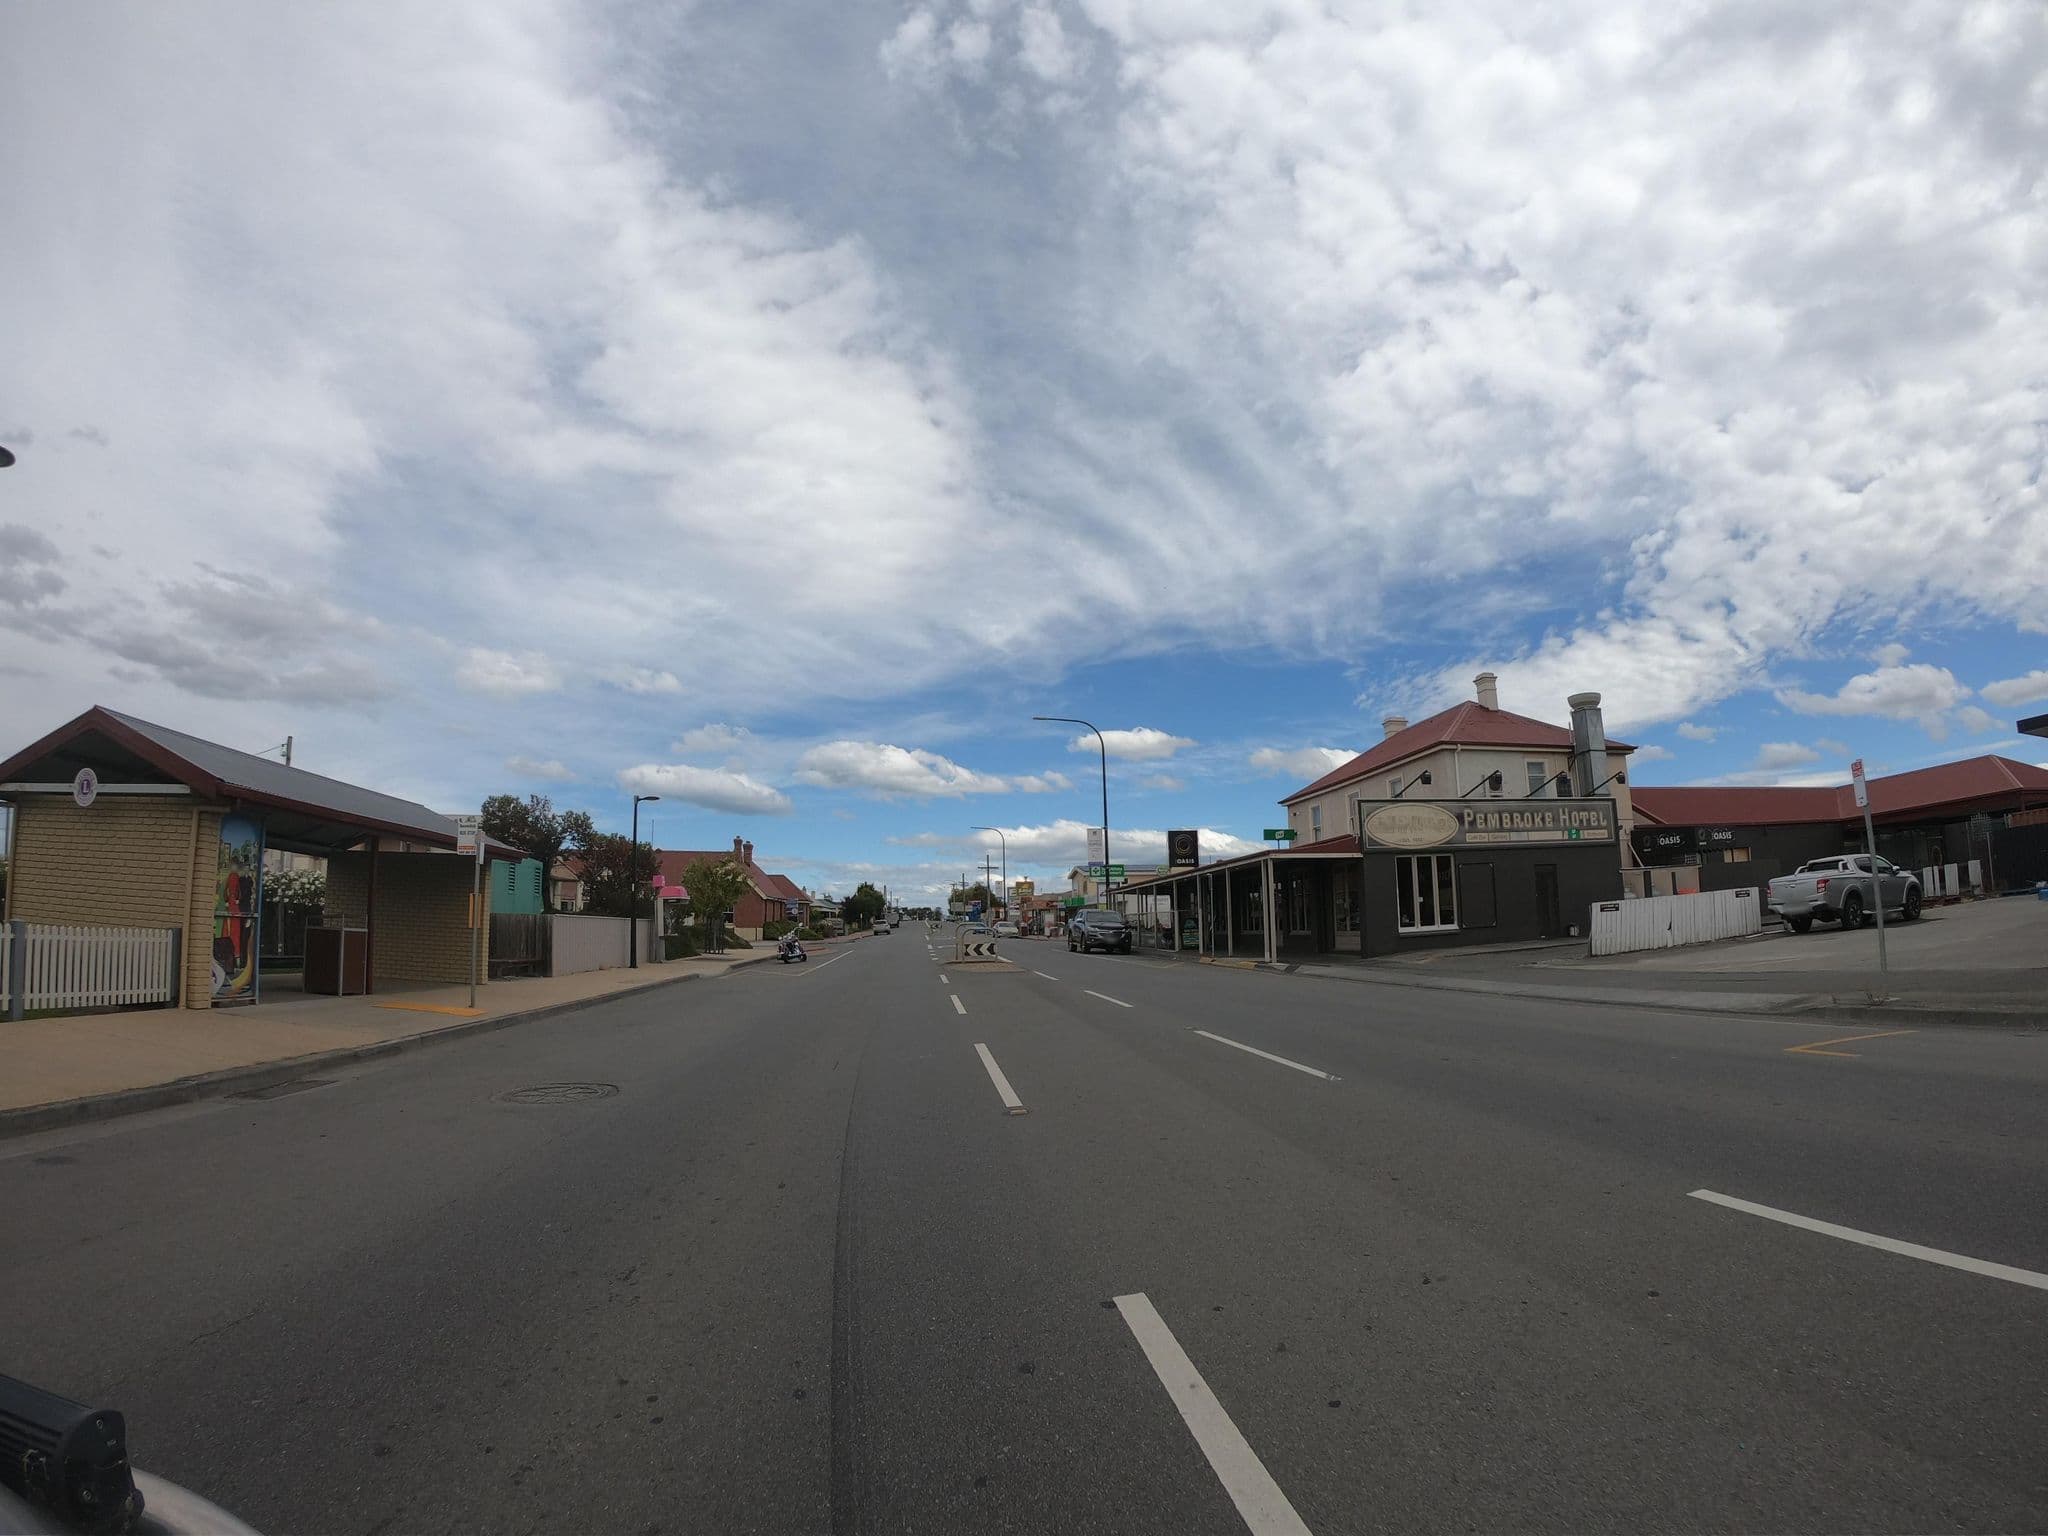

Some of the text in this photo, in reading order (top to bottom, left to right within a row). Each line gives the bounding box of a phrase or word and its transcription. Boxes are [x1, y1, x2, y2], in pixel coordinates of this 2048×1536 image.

[1463, 808, 1553, 829] PEMBROKE
[1559, 807, 1608, 827] HOTEL
[1659, 835, 1681, 846] OASIS
[1713, 831, 1732, 840] OASIS
